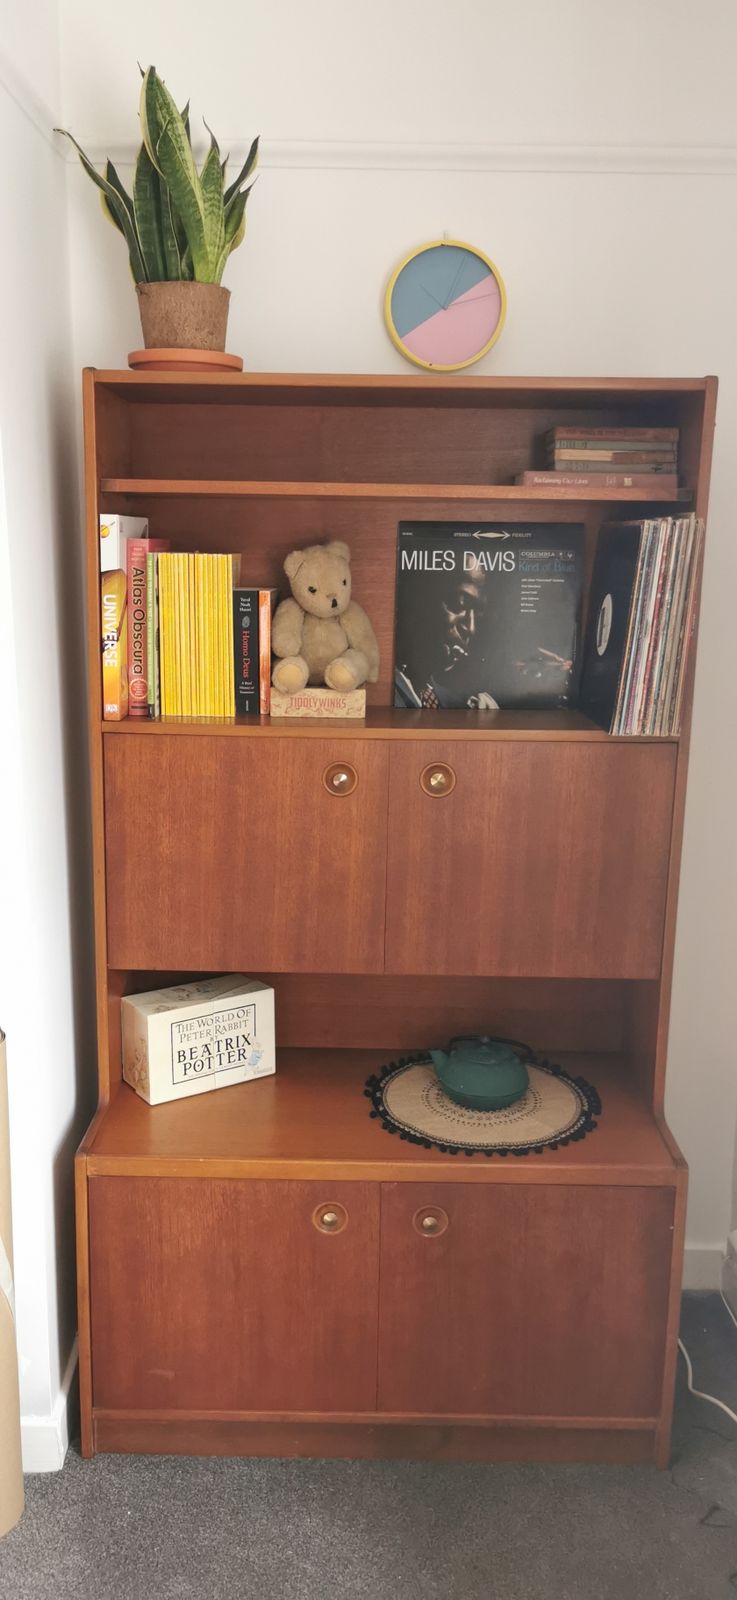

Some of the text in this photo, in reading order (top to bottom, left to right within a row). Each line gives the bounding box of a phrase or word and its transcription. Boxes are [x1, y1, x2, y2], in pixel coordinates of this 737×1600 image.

[401, 550, 516, 572] MILES DAVIS
[518, 561, 540, 571] Kind
[132, 567, 146, 605] Atlas
[103, 594, 118, 667] UNIVERSE
[132, 609, 146, 675] Obscura
[242, 630, 251, 678] Homo Deus
[289, 697, 347, 709] TIDDLYWINKS
[175, 1008, 252, 1033] THE WORLD OF
[179, 1019, 249, 1043] PETER RABBIT
[177, 1033, 251, 1063] BEATRIX
[183, 1048, 247, 1076] POTTER
